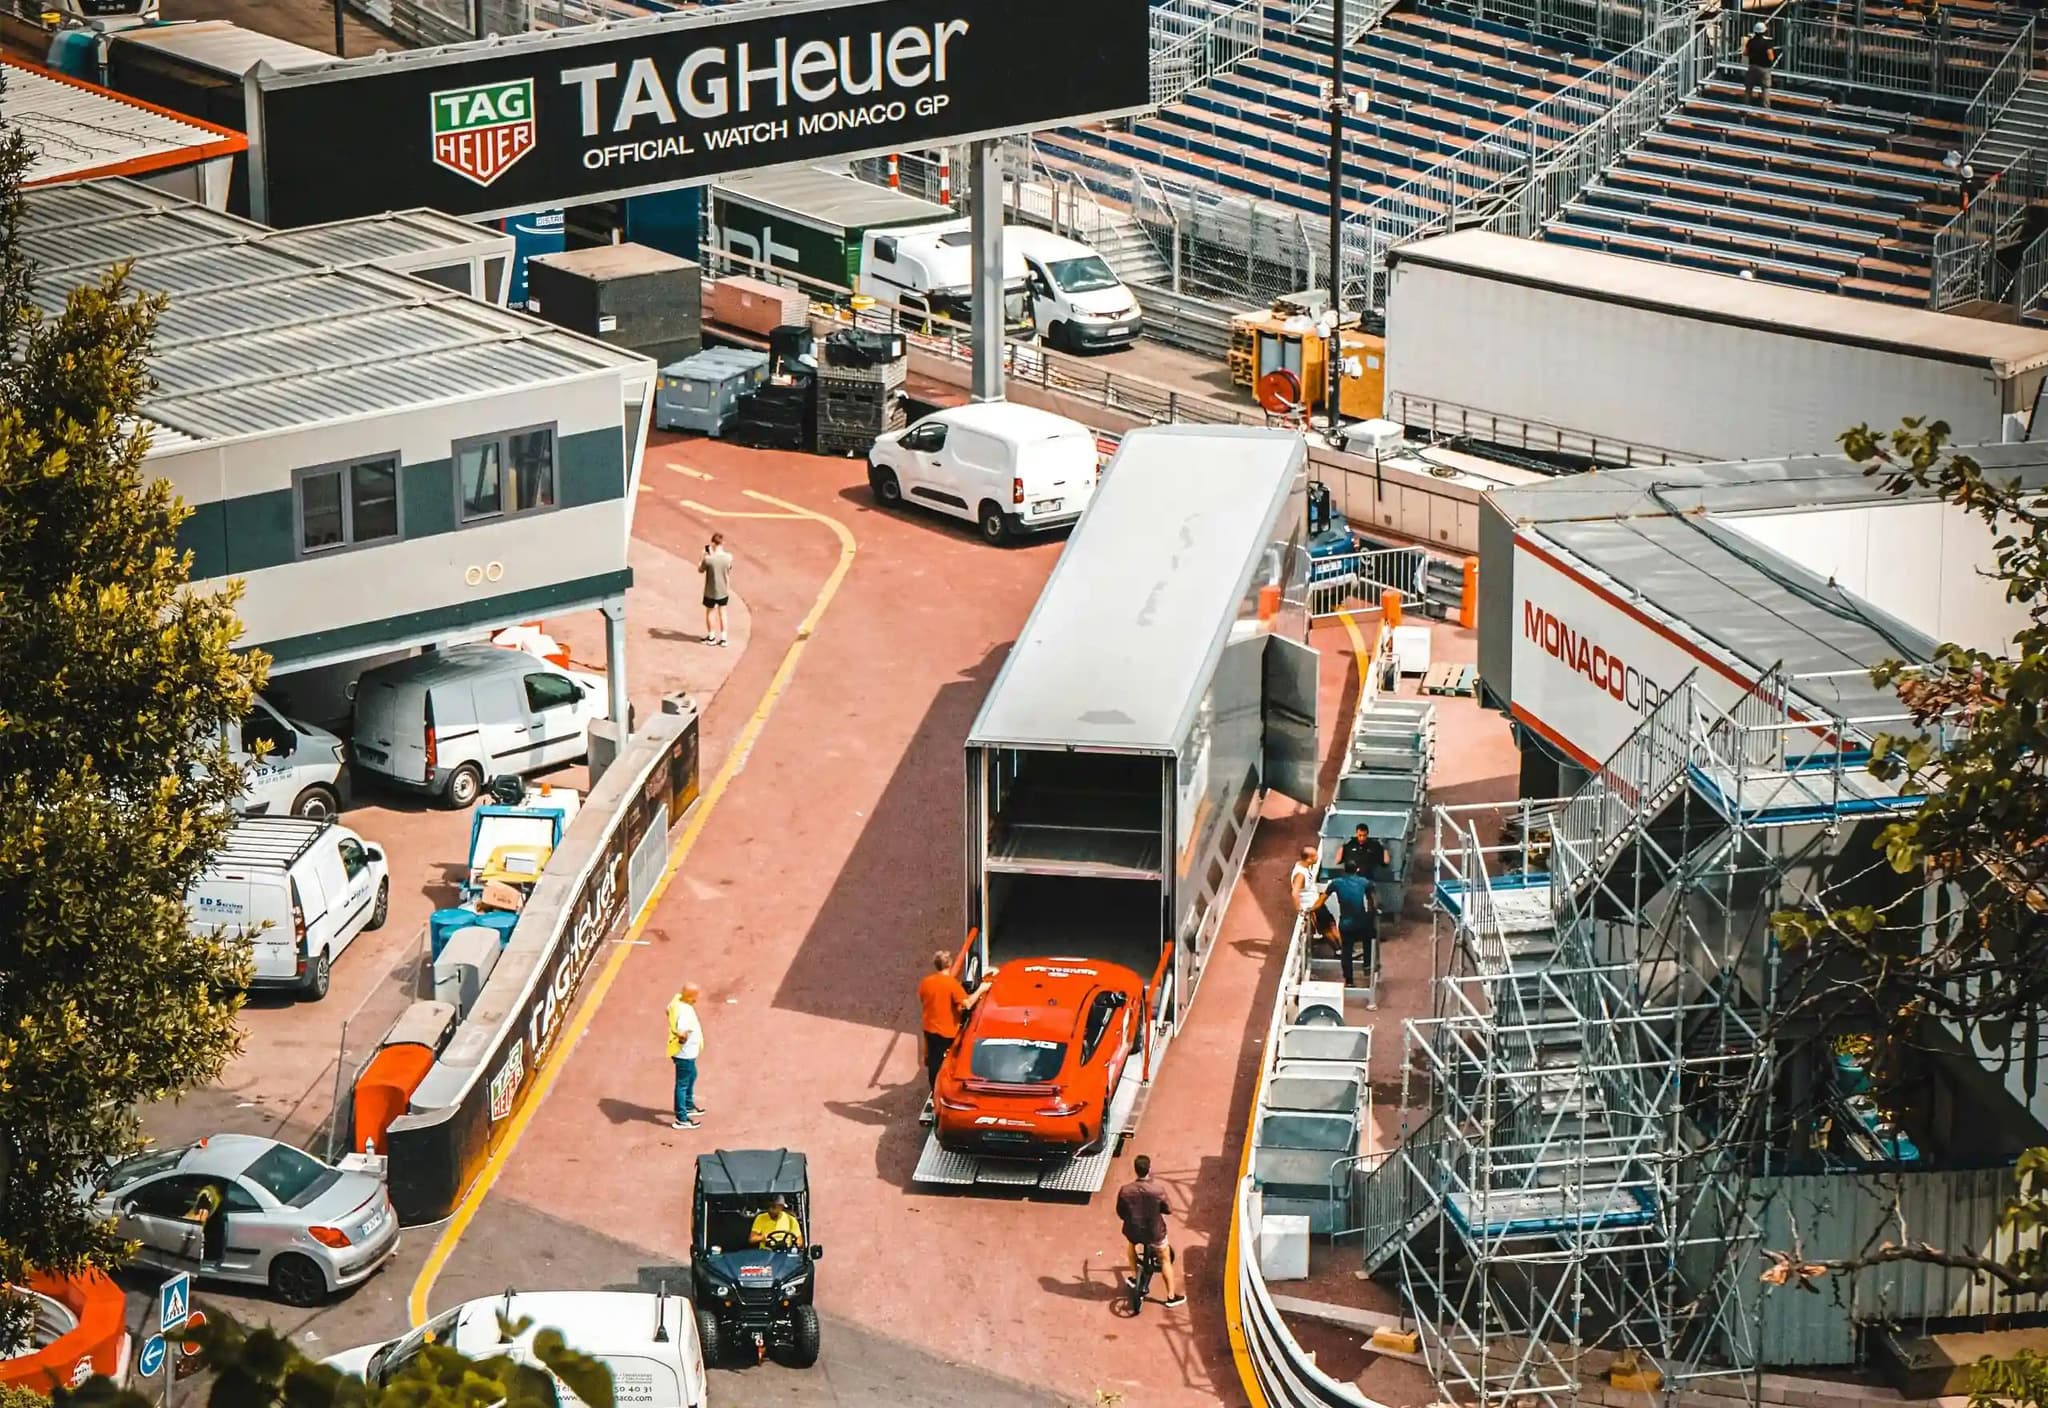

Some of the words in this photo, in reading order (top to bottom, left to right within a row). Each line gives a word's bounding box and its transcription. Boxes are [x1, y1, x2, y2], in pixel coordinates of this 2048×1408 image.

[440, 87, 525, 127] TAG
[439, 125, 529, 178] HEUER
[583, 135, 695, 170] OFFICIAL
[704, 120, 789, 151] WATCH
[798, 101, 906, 137] MONACO
[915, 94, 950, 118] GP
[200, 897, 213, 905] ED
